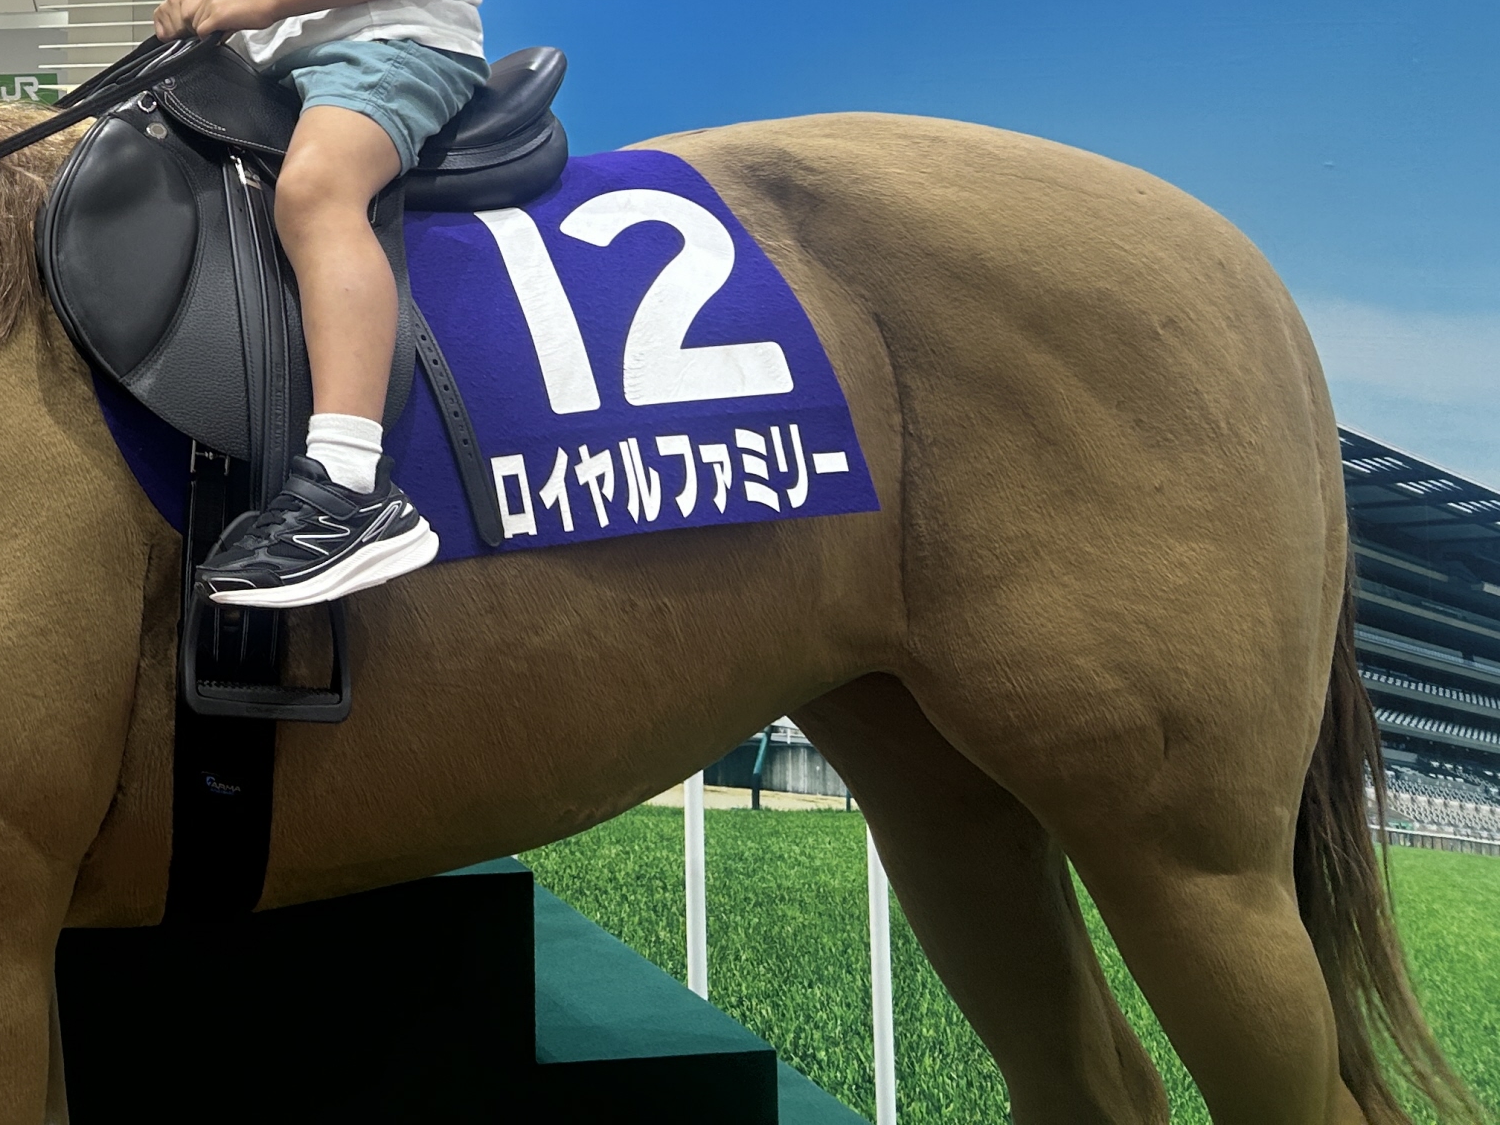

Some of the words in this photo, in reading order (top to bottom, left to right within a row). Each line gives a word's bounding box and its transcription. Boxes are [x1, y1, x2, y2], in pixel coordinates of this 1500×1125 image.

[1, 76, 39, 101] JR
[473, 188, 794, 415] 12
[491, 424, 849, 538] ロイヤルファミリー
